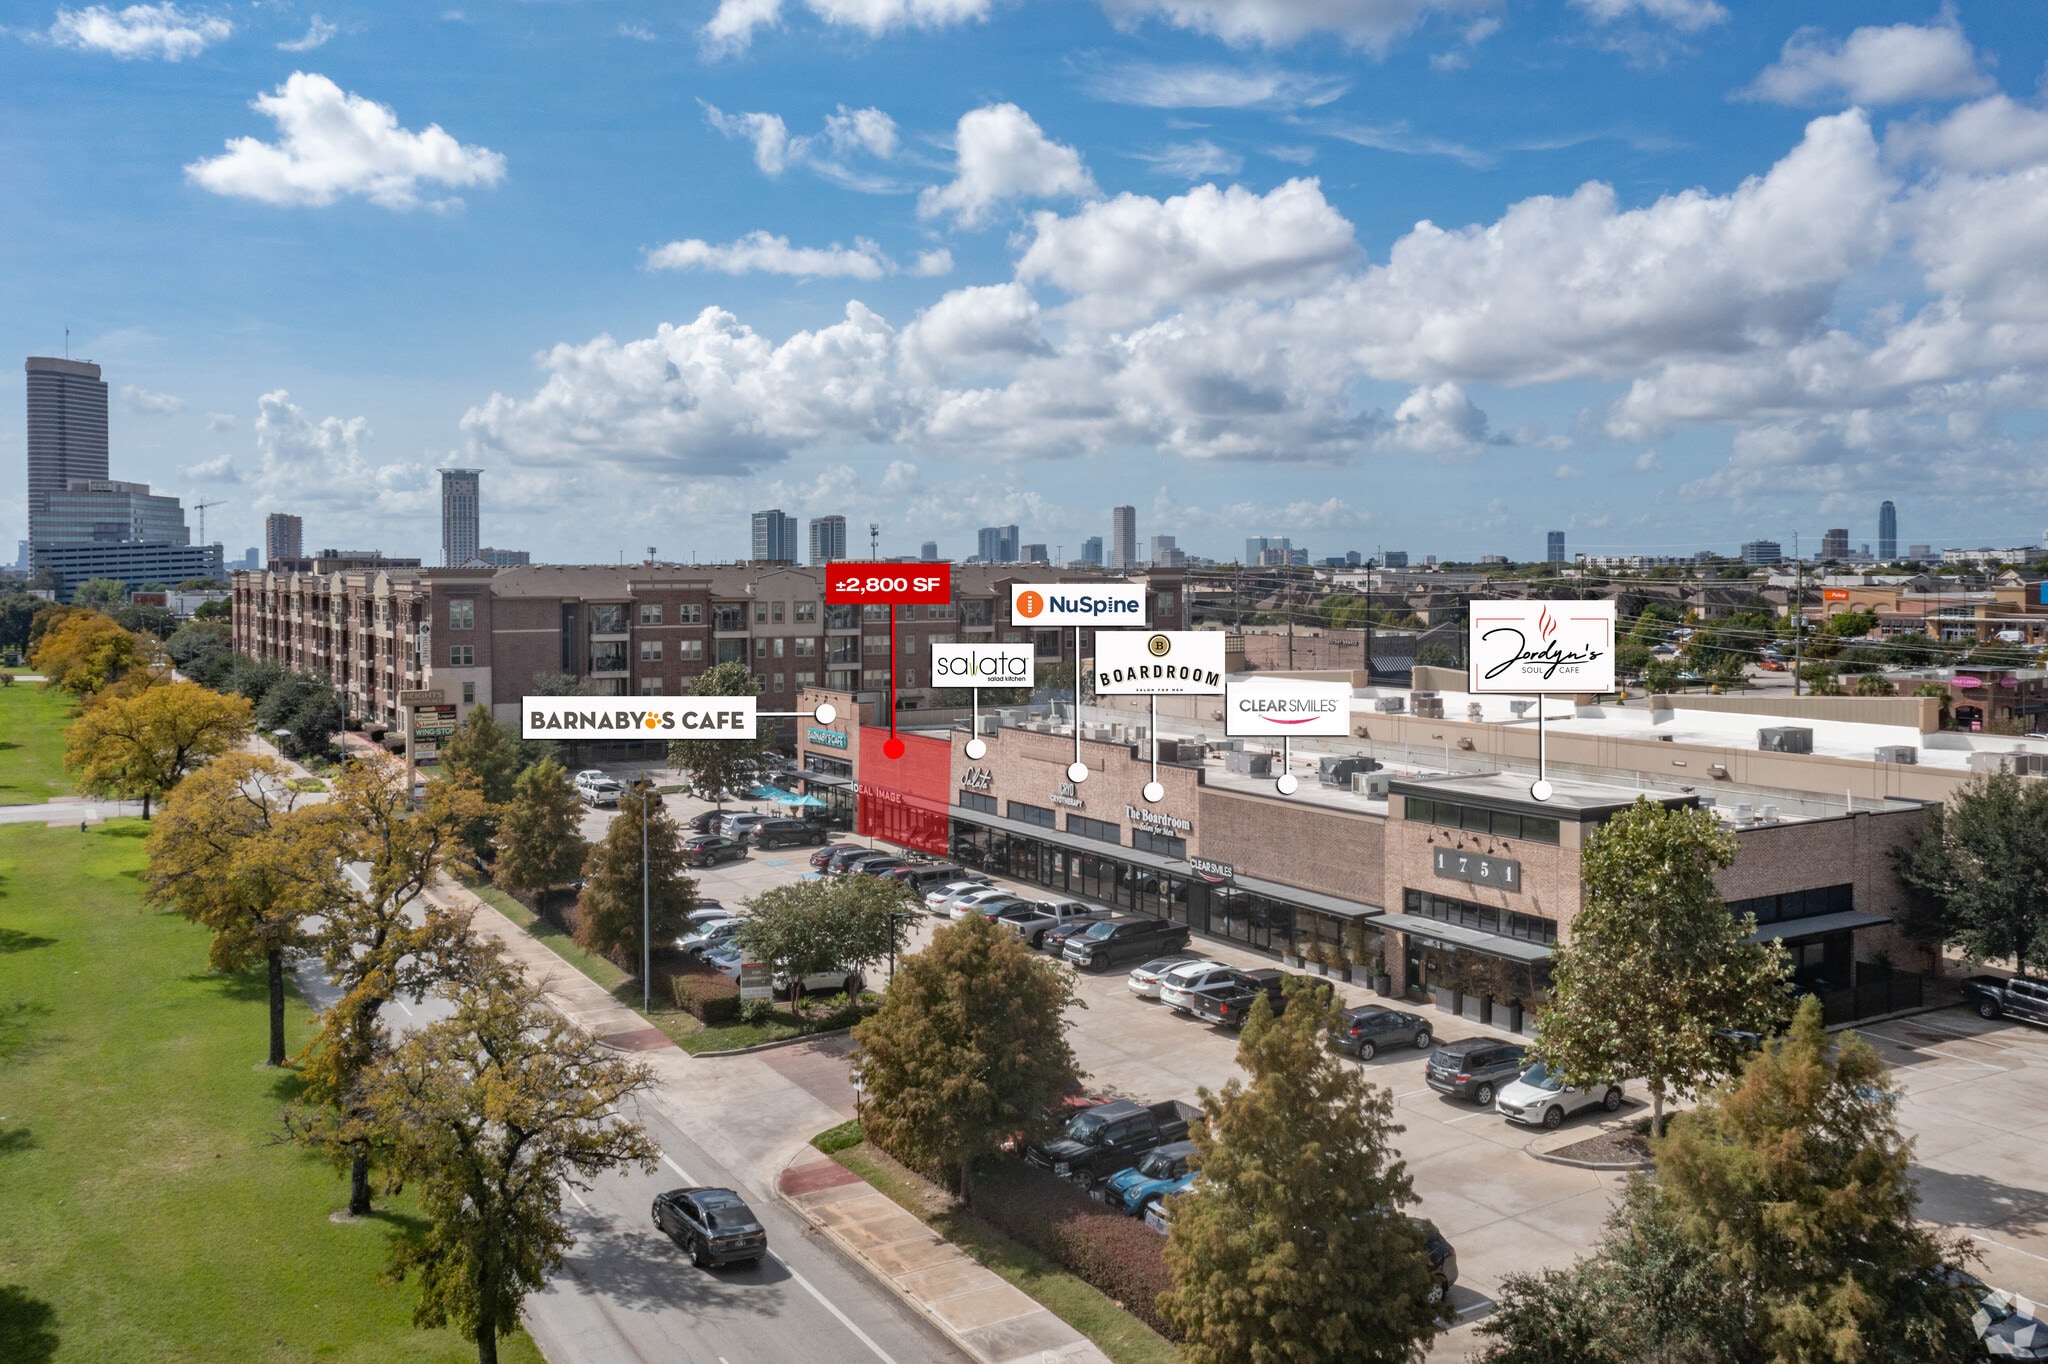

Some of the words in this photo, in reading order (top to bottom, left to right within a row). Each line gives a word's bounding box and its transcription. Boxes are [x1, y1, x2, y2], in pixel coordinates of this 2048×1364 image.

[402, 691, 442, 699] HEIGHTS
[831, 735, 844, 746] CAFE
[961, 766, 991, 789] Salata
[1125, 805, 1140, 820] The
[1141, 809, 1191, 831] Boardroom
[1139, 822, 1154, 833] Salon
[1152, 824, 1162, 835] for
[1161, 827, 1174, 837] Men
